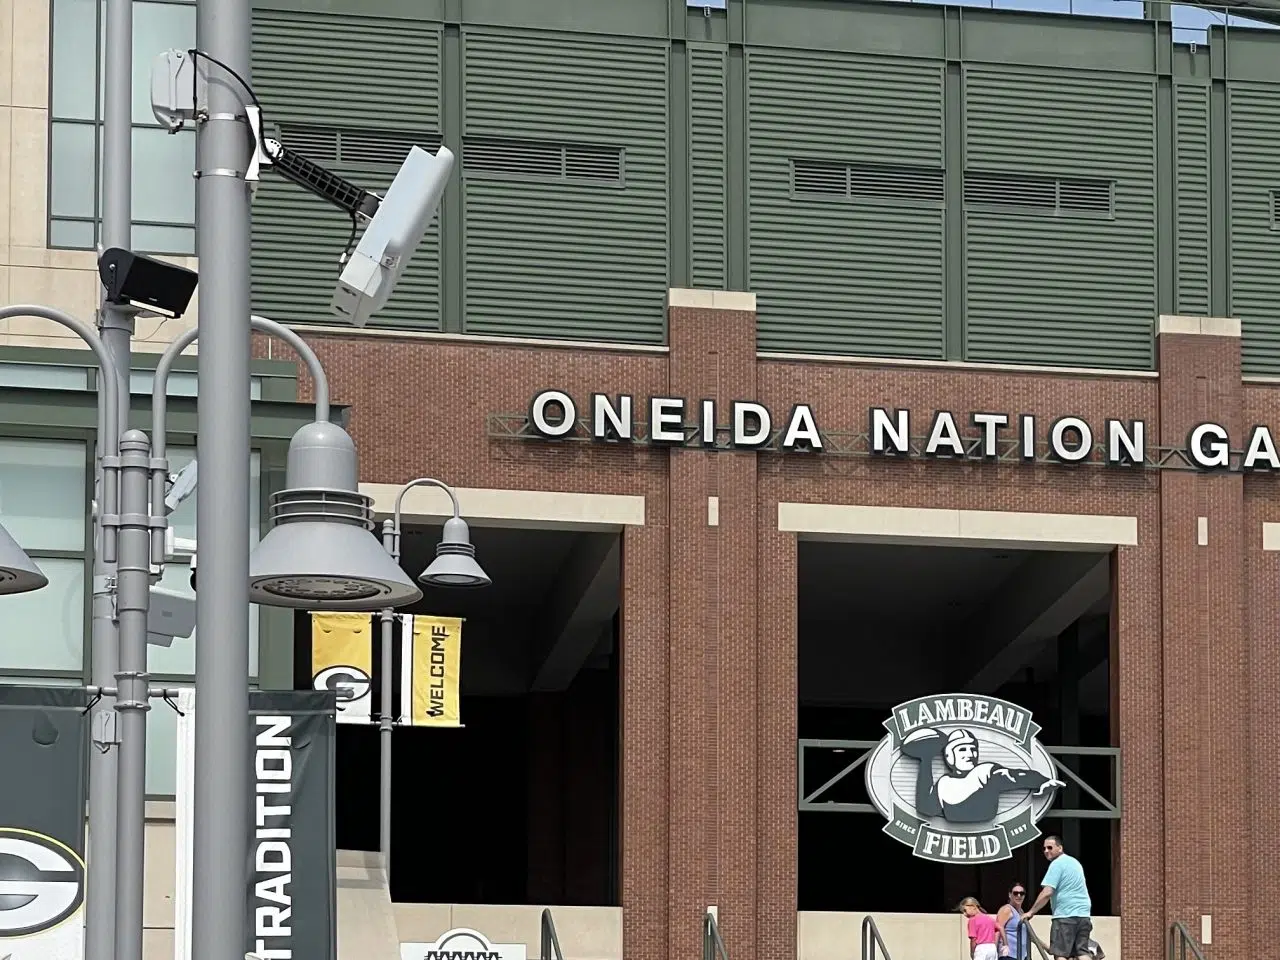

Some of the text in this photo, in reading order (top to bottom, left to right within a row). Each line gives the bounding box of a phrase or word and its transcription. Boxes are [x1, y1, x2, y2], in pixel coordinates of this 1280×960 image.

[531, 389, 823, 449] ONEIDA
[872, 407, 1145, 464] NATION
[429, 625, 447, 717] WELCOME
[898, 698, 1025, 735] LAMBEAU
[255, 715, 292, 960] TRADITION
[922, 831, 1001, 859] FIELD
